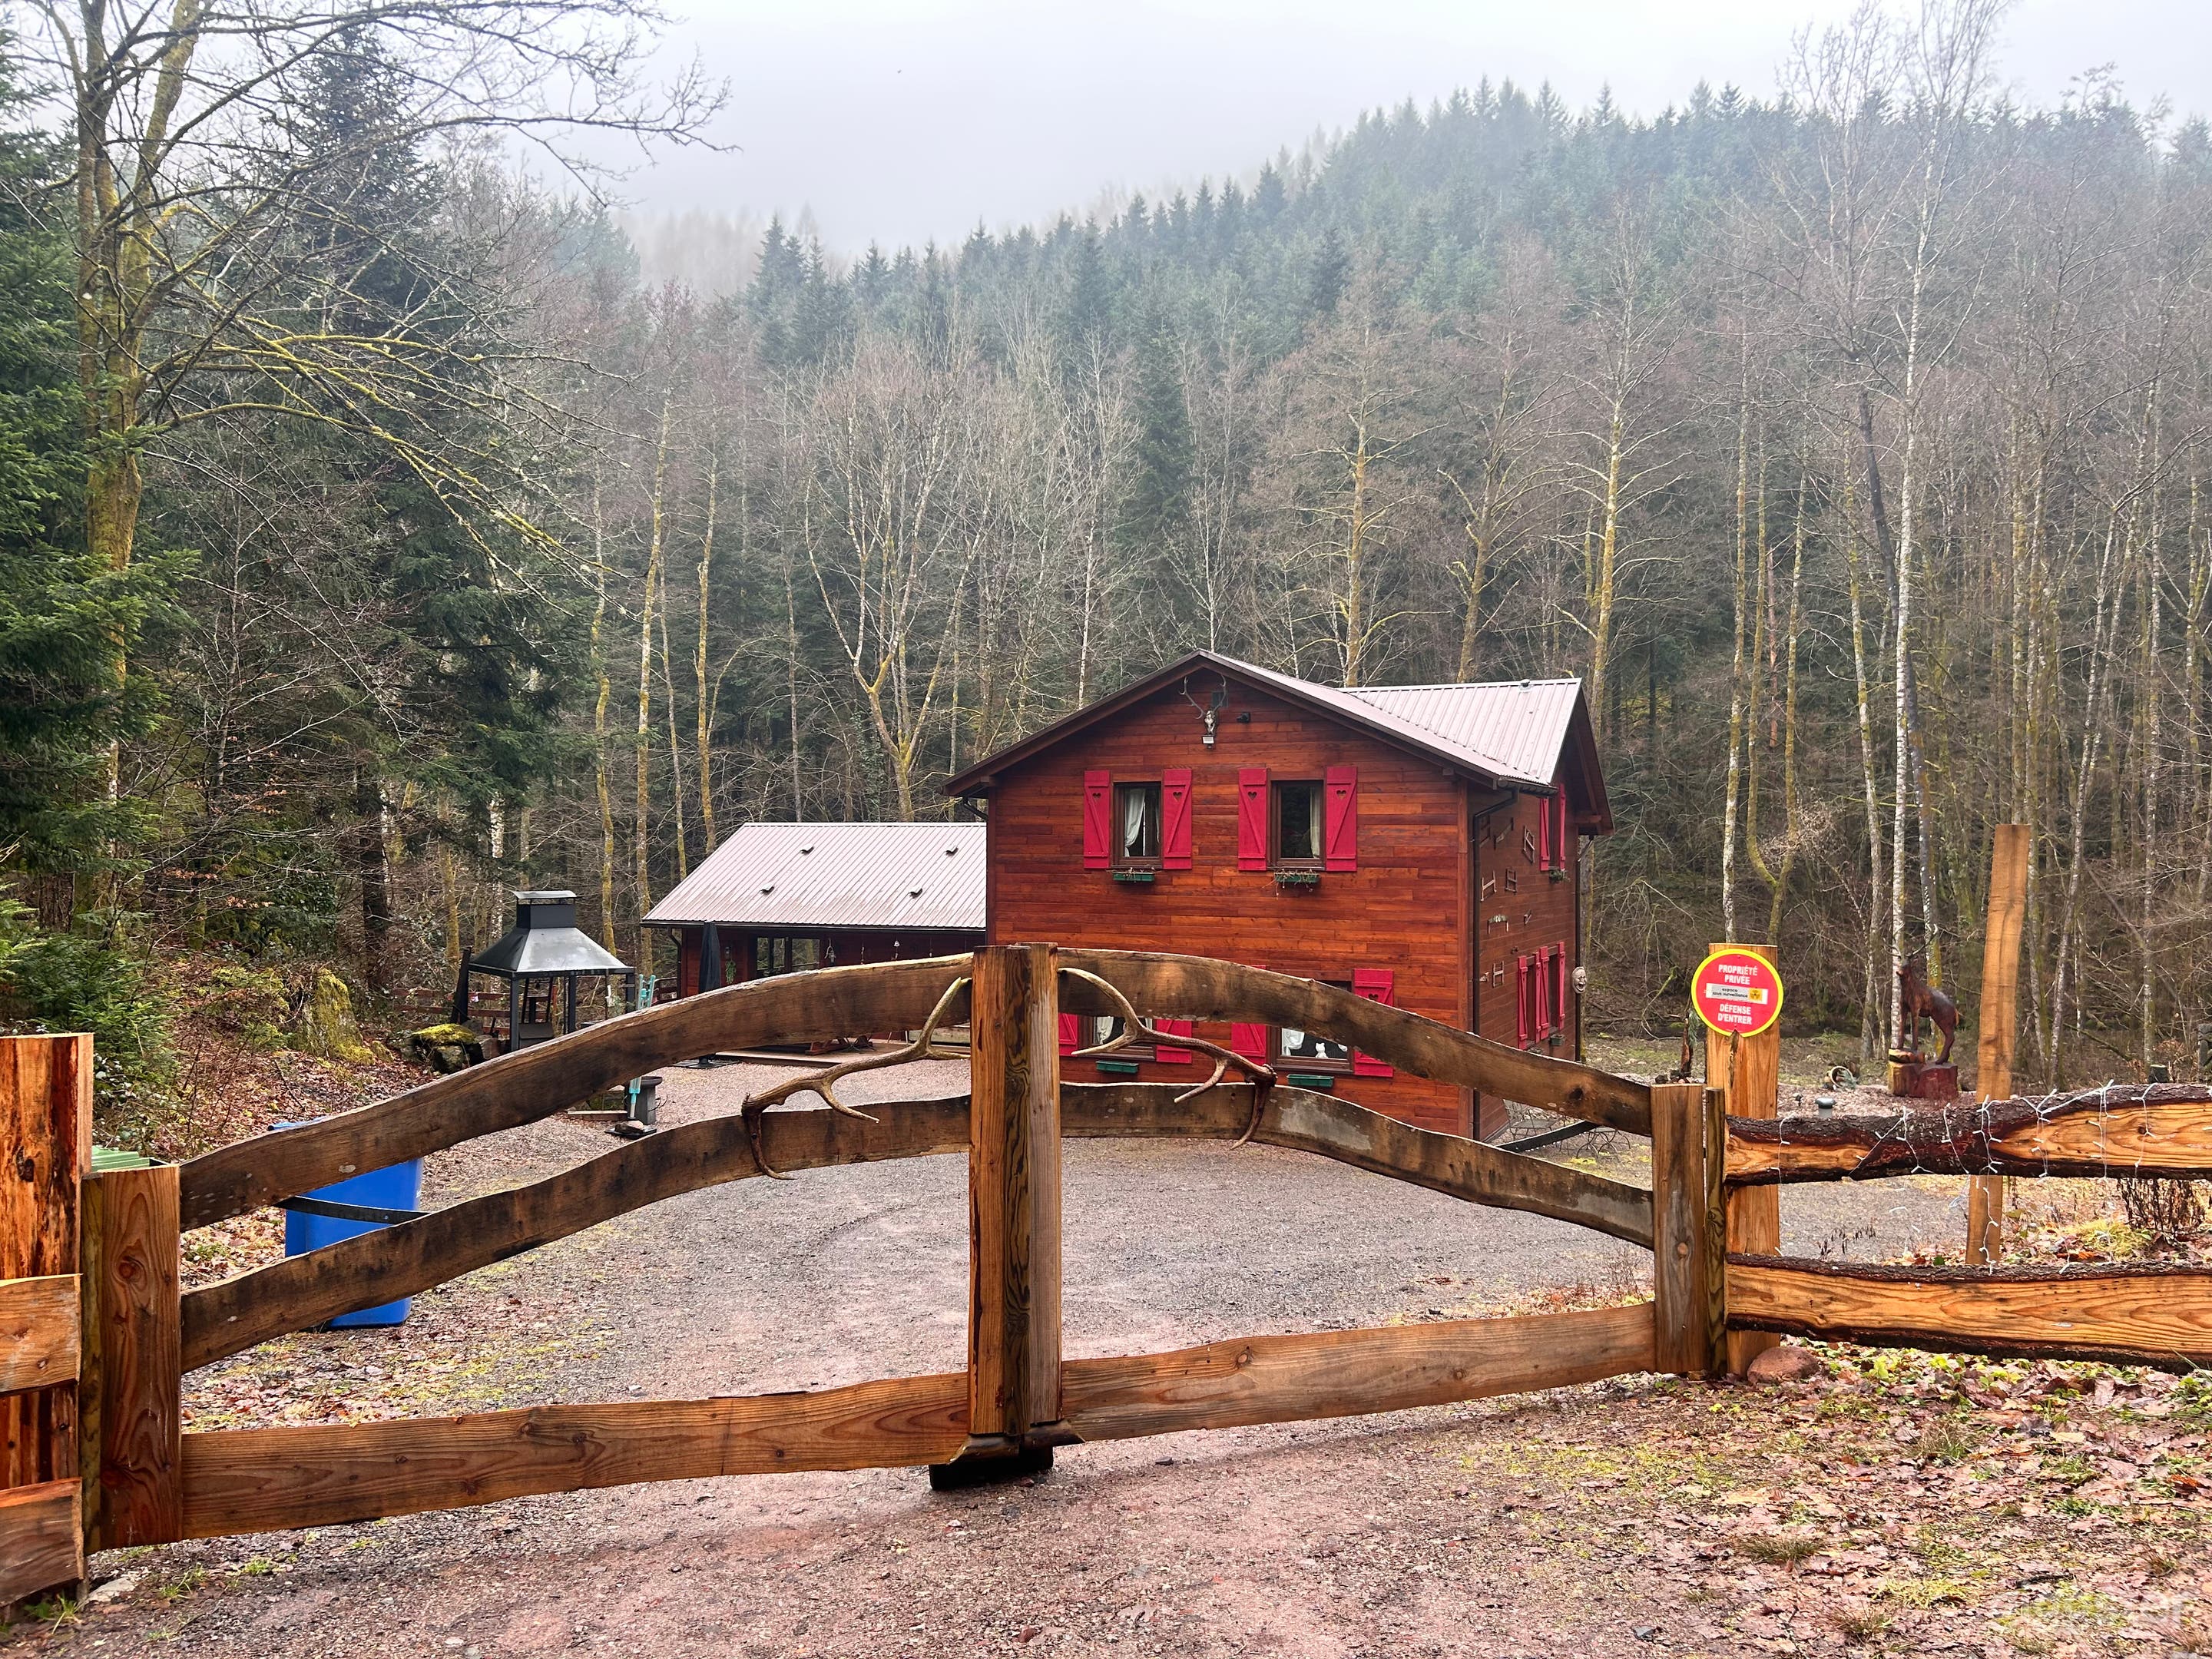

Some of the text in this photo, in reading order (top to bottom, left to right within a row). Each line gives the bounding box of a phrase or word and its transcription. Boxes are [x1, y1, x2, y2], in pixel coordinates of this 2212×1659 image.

[1718, 964, 1758, 975] PROPRIÉTÉ
[1724, 974, 1750, 985] PRIVÉE
[1720, 1003, 1751, 1015] DÉFENSE
[1717, 1013, 1752, 1025] D'ENTRER
